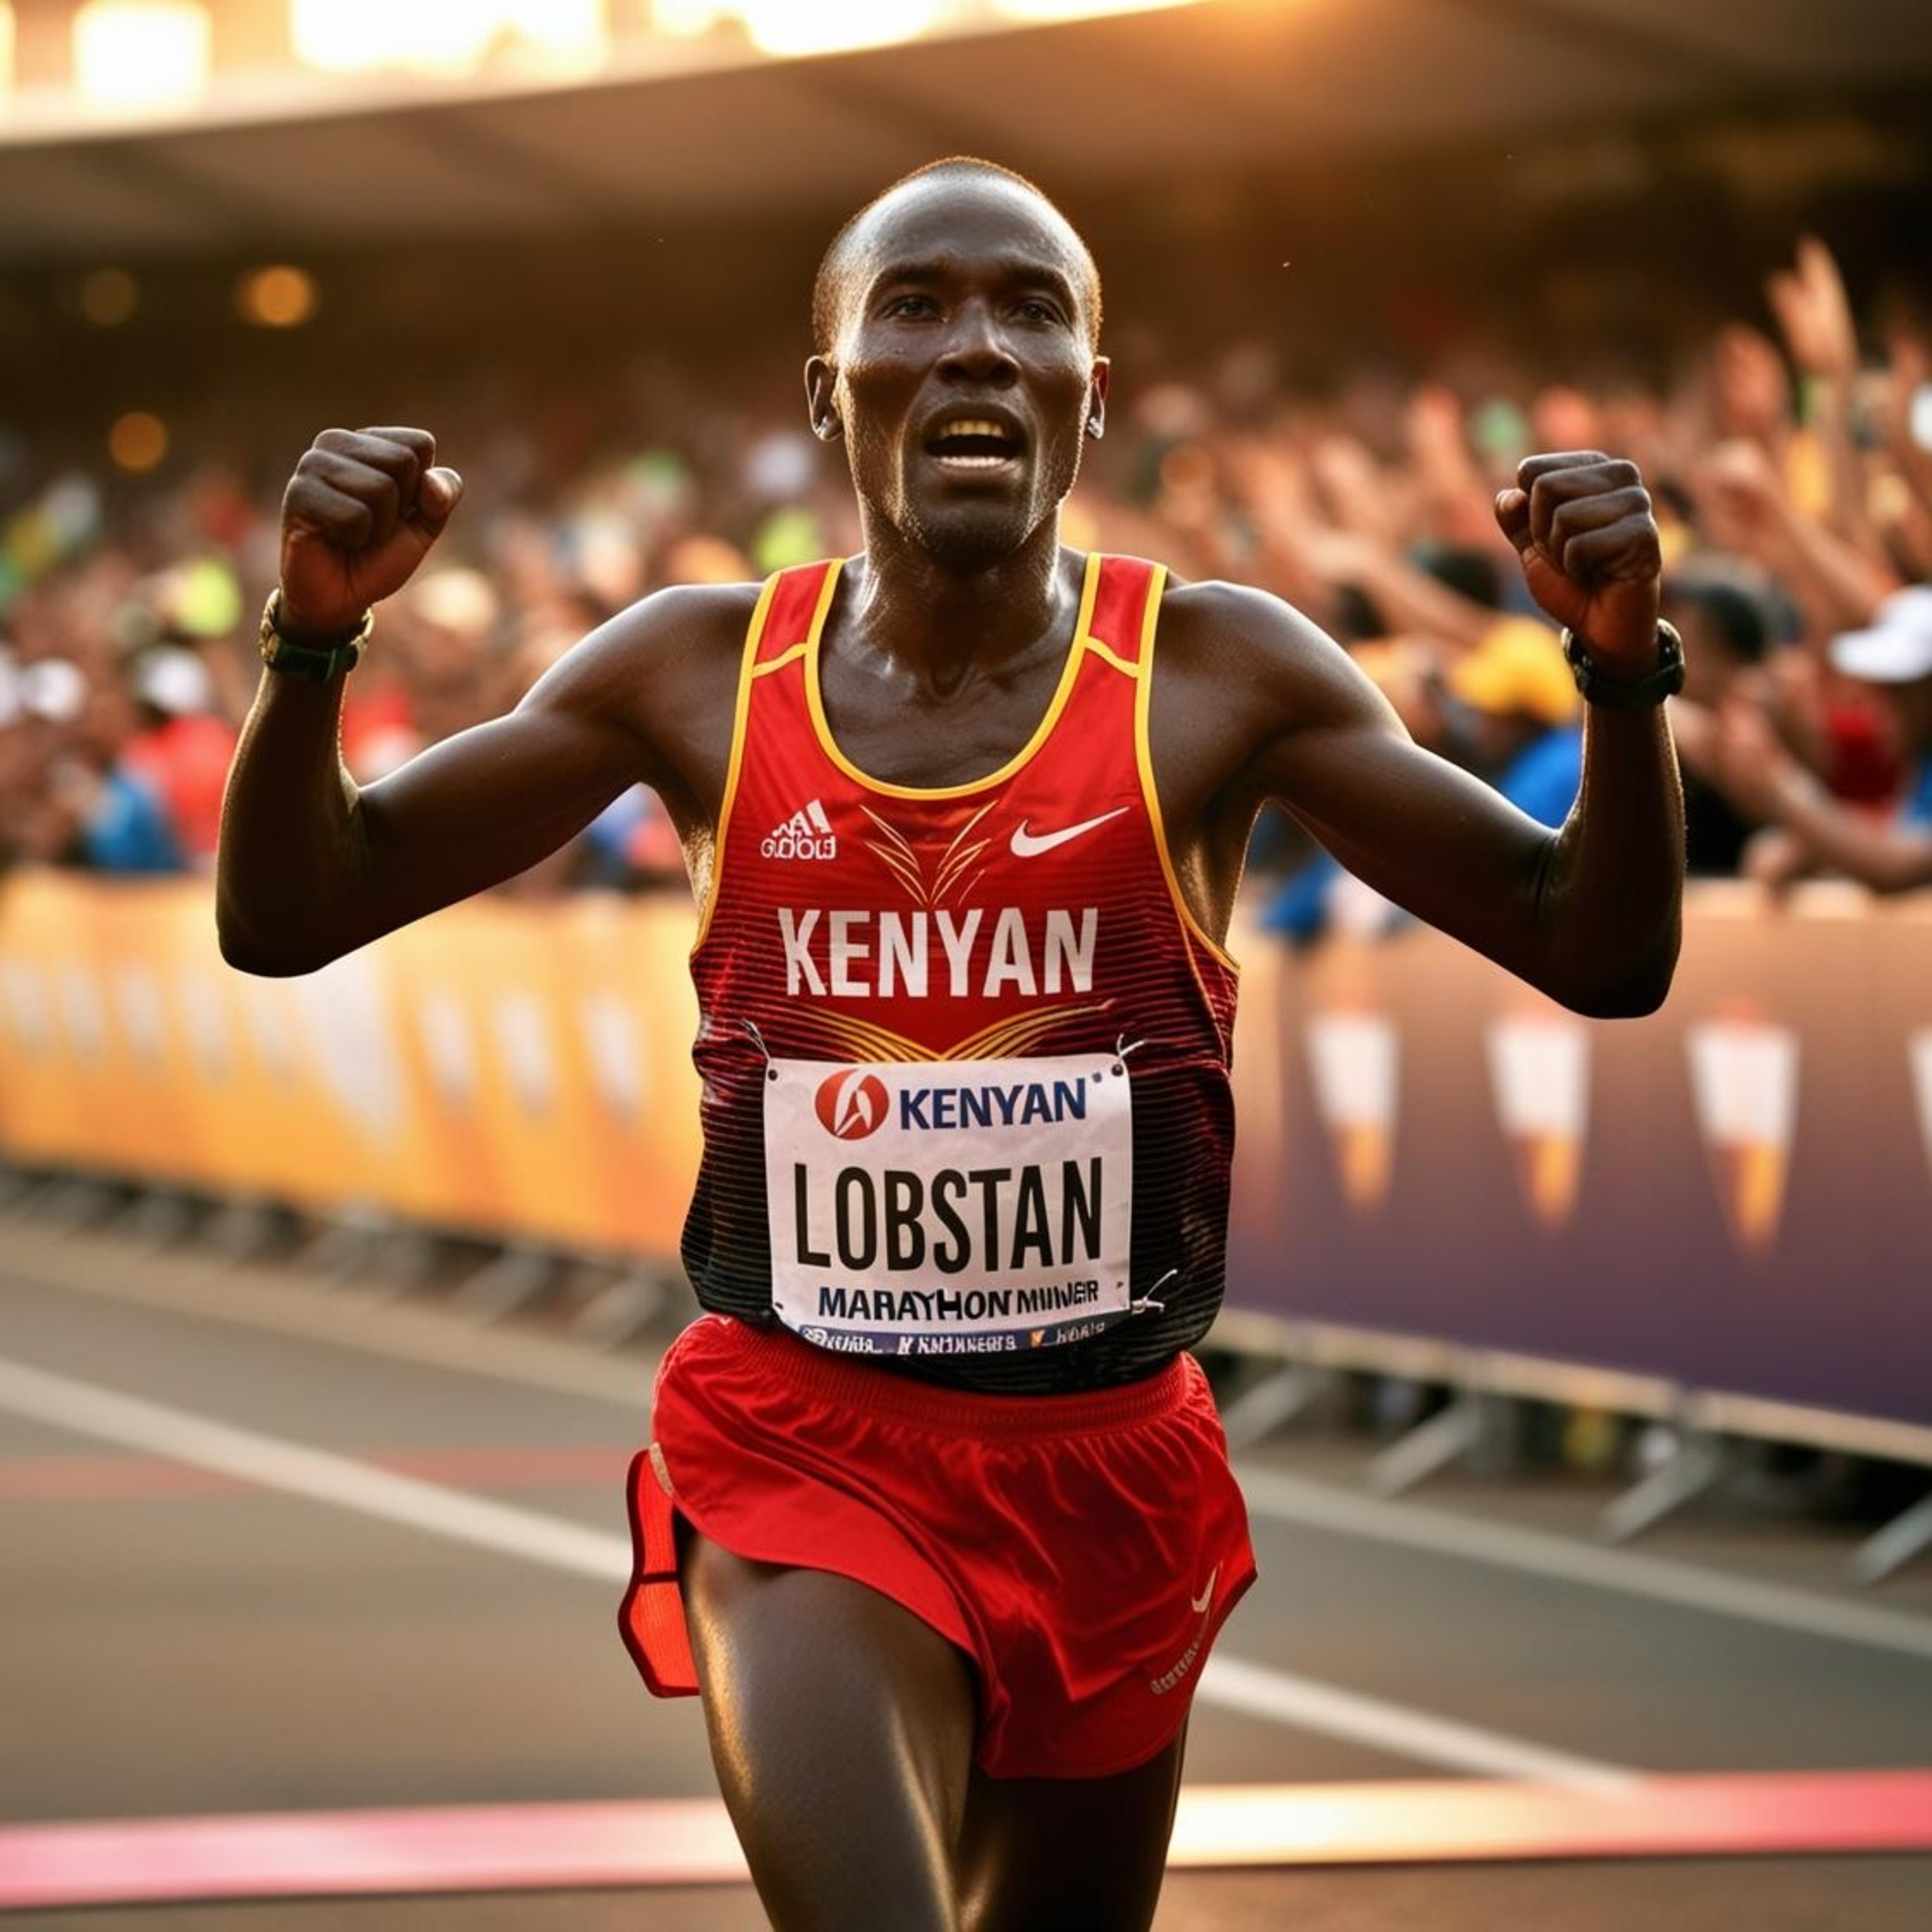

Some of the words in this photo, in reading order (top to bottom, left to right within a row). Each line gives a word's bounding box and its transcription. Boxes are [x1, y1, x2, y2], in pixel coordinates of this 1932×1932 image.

[779, 908, 1097, 997] KENYAN
[900, 1078, 1086, 1130] KENYAN
[794, 1157, 1102, 1274] LOBSTAN
